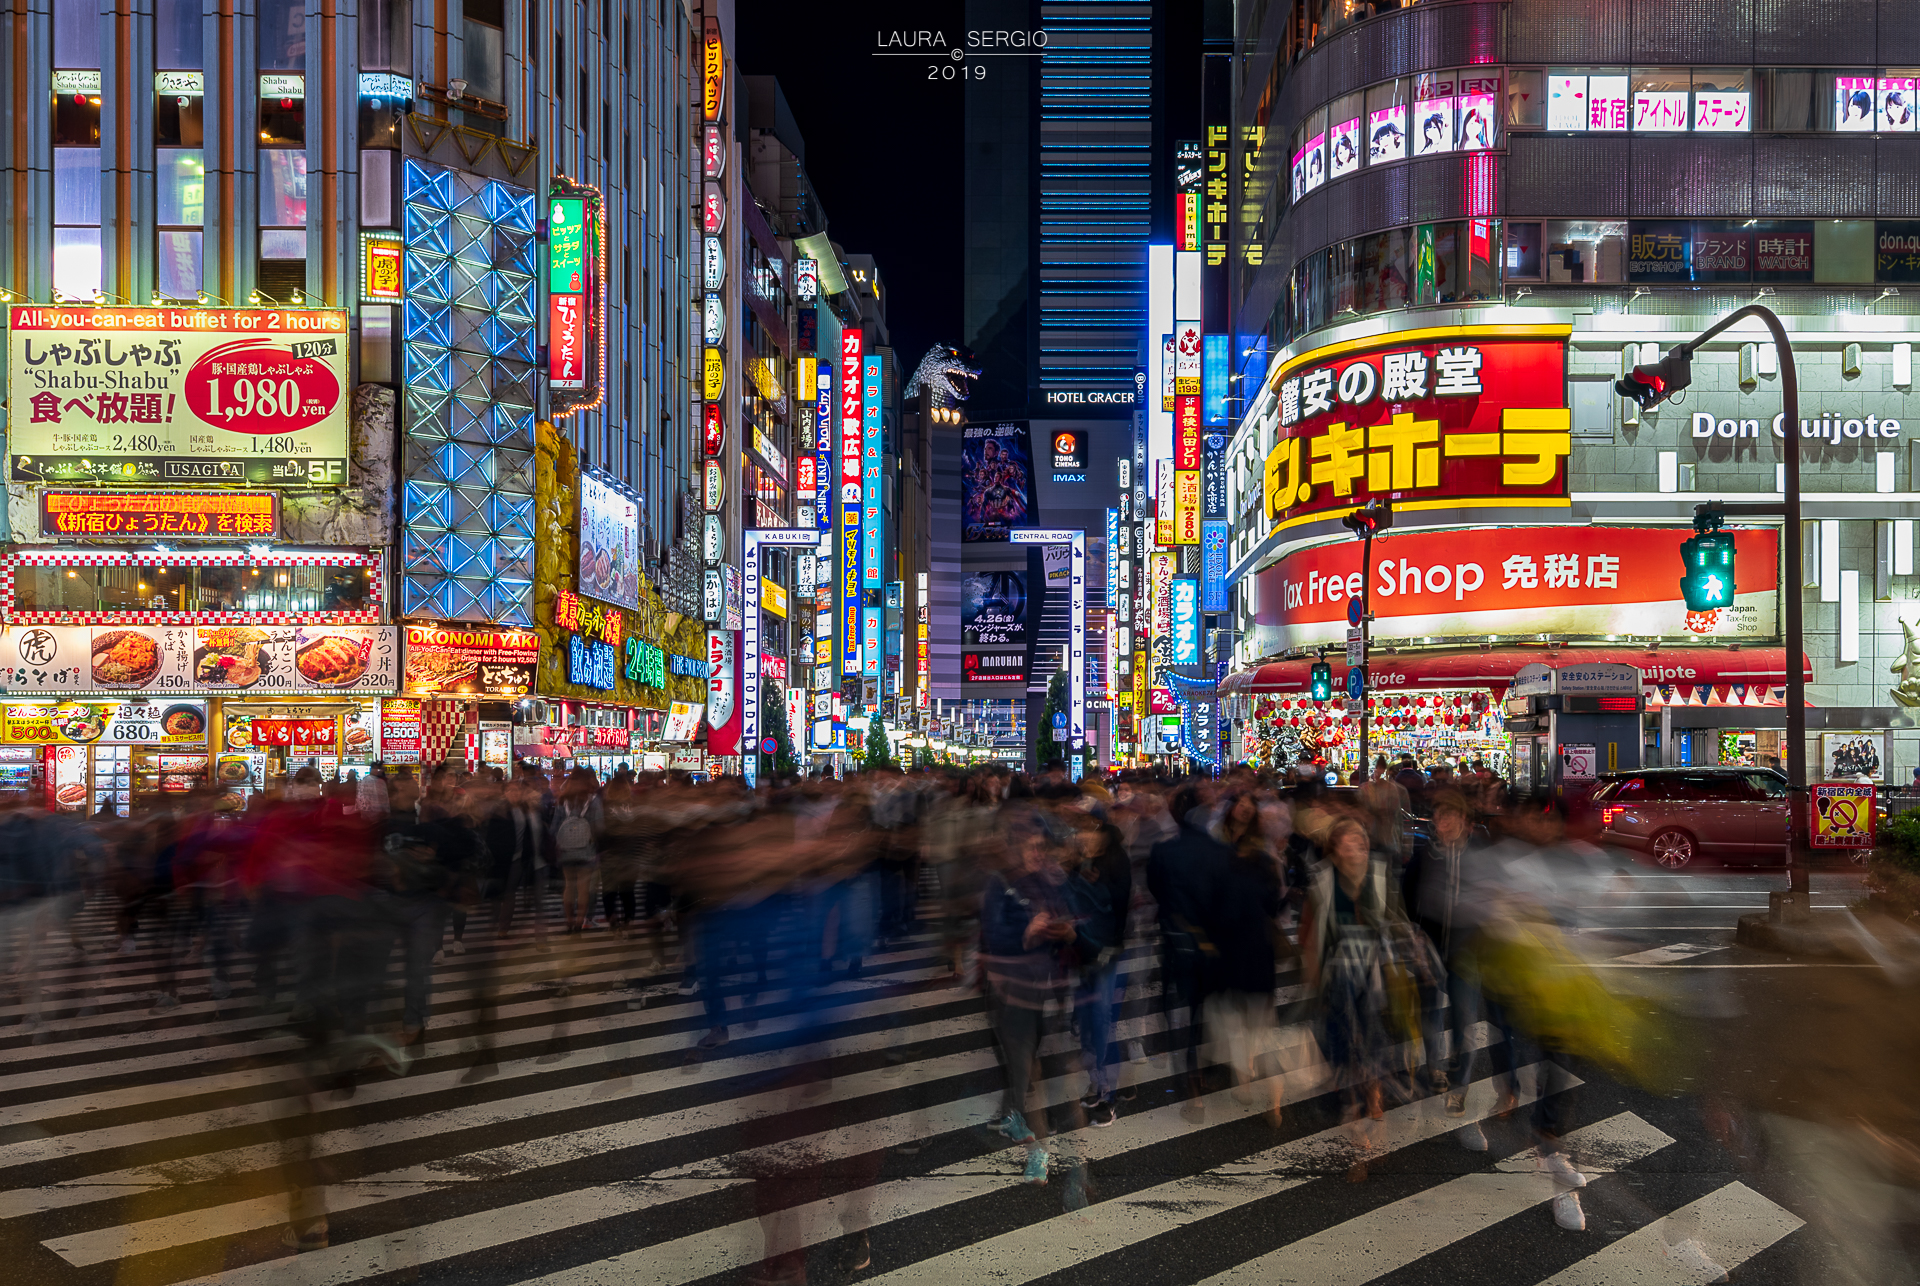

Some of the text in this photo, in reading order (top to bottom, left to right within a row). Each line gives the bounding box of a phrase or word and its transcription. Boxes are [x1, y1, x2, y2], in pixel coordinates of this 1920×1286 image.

[263, 77, 288, 85] Shabu
[278, 86, 302, 95] Shabu
[1590, 98, 1747, 129] 新宿 ステージ
[1186, 196, 1196, 239] Garam
[553, 241, 580, 253] サラダ
[1631, 234, 1682, 260] 販売
[1695, 239, 1746, 256] ブランド
[1758, 238, 1810, 256] 時計
[377, 258, 396, 284] 虎の子
[552, 258, 581, 269] スイーツ
[1696, 256, 1746, 269] BRAND
[1758, 256, 1809, 269] WATCH
[706, 280, 718, 288] 6F
[558, 297, 577, 306] 新宿
[18, 310, 341, 331] All-you-can-eat buffet for 2 hours
[24, 337, 182, 366] しゃぶしゃぶ
[294, 340, 333, 359] 120分
[557, 306, 577, 378] ひょうたん
[706, 362, 721, 389] 虎の子
[1280, 346, 1483, 428] 驚安の殿堂
[205, 378, 326, 422] 1,980 yen
[843, 334, 860, 477] カラオケ歌広場
[1047, 392, 1086, 404] HOTEL
[1185, 398, 1195, 406] 5F
[1691, 411, 1760, 439] Don
[112, 434, 176, 453] 2,480 yen
[250, 436, 312, 455] 1,480 yen
[1182, 407, 1198, 467] 豊後高田どり
[308, 461, 342, 481] 5F
[1053, 474, 1086, 482] IMAX
[1182, 482, 1197, 504] 酒場
[1185, 512, 1195, 538] 280
[1283, 553, 1620, 612] Tax Free Shop 免税店
[1208, 591, 1222, 600] 5F
[1725, 614, 1758, 623] Tax-free
[1729, 604, 1758, 613] Japan.
[848, 606, 857, 653] Tax Free Shop
[1176, 582, 1195, 661] カラオケ
[1736, 623, 1758, 632] Shop
[22, 629, 53, 662] 虎
[164, 630, 176, 652] そば
[409, 629, 539, 649] OKONOMI YAKI
[724, 631, 733, 665] 大衆酒場
[745, 560, 756, 719] GODZILLA ROAD
[866, 617, 878, 670] カラオ
[979, 633, 1010, 643] 終わる。
[1073, 575, 1084, 708] ゴジラロード
[177, 629, 188, 672] かき揚げ
[270, 630, 280, 673] ラーメン
[281, 630, 292, 673] とんこつ
[377, 628, 393, 671] かつ丼
[498, 649, 538, 658] Free-Flowing
[569, 634, 614, 690] 飲み放題
[627, 637, 665, 690] 24時間
[710, 635, 723, 692] トラノコ
[982, 655, 1023, 667] MARUHAN
[157, 675, 190, 688] 450円
[258, 674, 292, 688] 500円
[361, 674, 395, 687] 520円
[1561, 672, 1633, 681] 安全安心ステーション
[1153, 691, 1168, 704] 2F
[7, 706, 91, 718] とんこつラーメン
[113, 725, 158, 740] 680円
[257, 726, 334, 742] とらそば
[1197, 702, 1210, 753] カラオケ
[1817, 787, 1873, 797] 新宿区内全域
